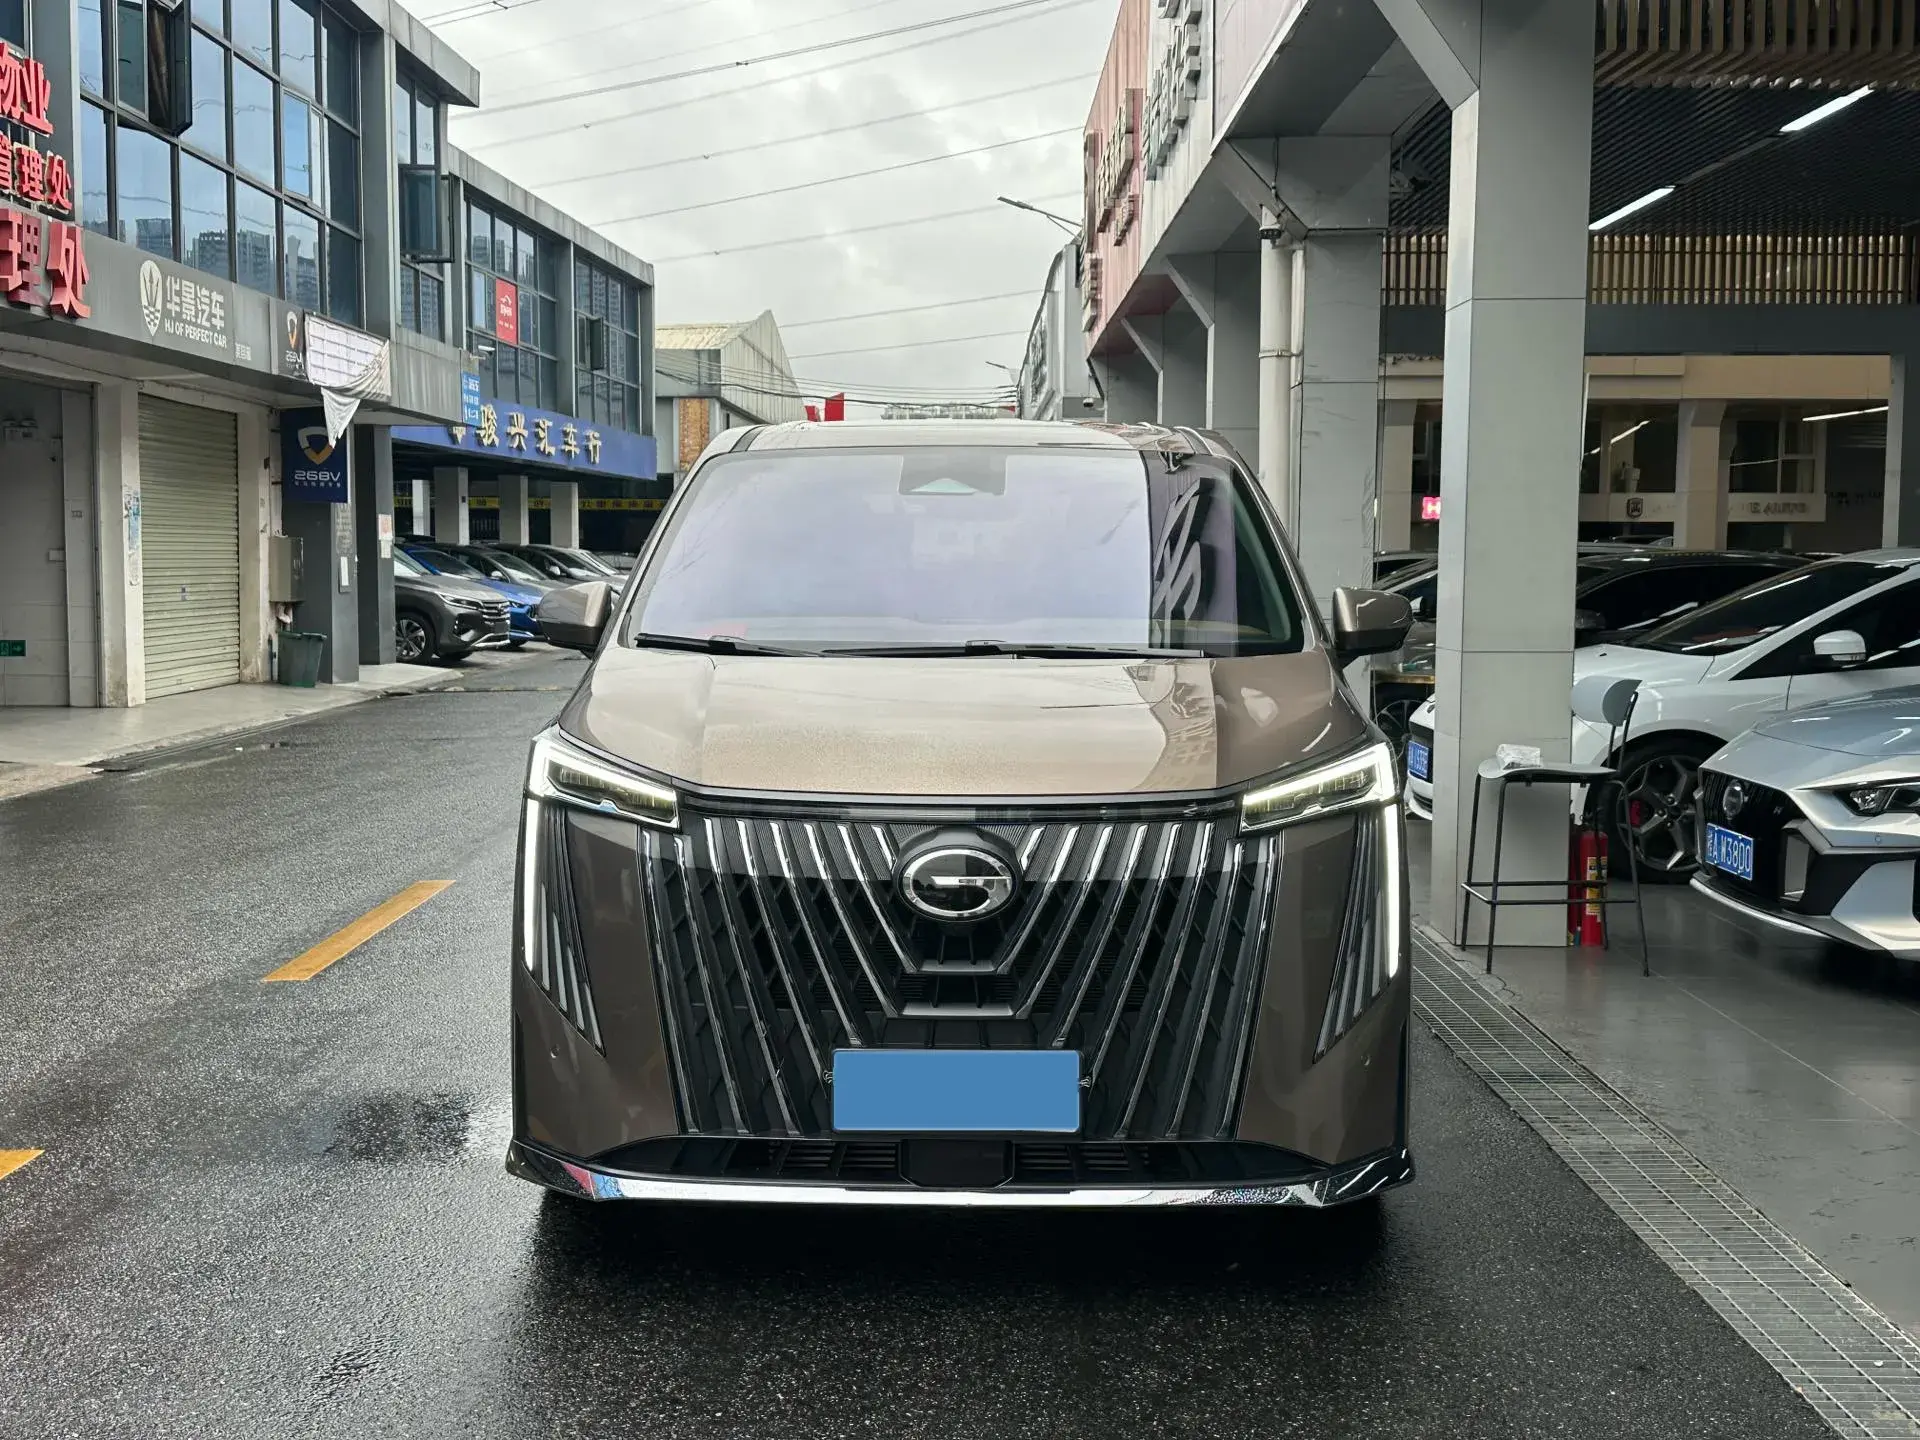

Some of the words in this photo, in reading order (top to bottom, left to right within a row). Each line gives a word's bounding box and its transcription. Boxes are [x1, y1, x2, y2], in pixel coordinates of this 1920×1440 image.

[166, 275, 225, 330] 华景汽车
[175, 322, 184, 337] OF
[185, 324, 213, 345] PERFECT
[213, 332, 227, 348] CAR
